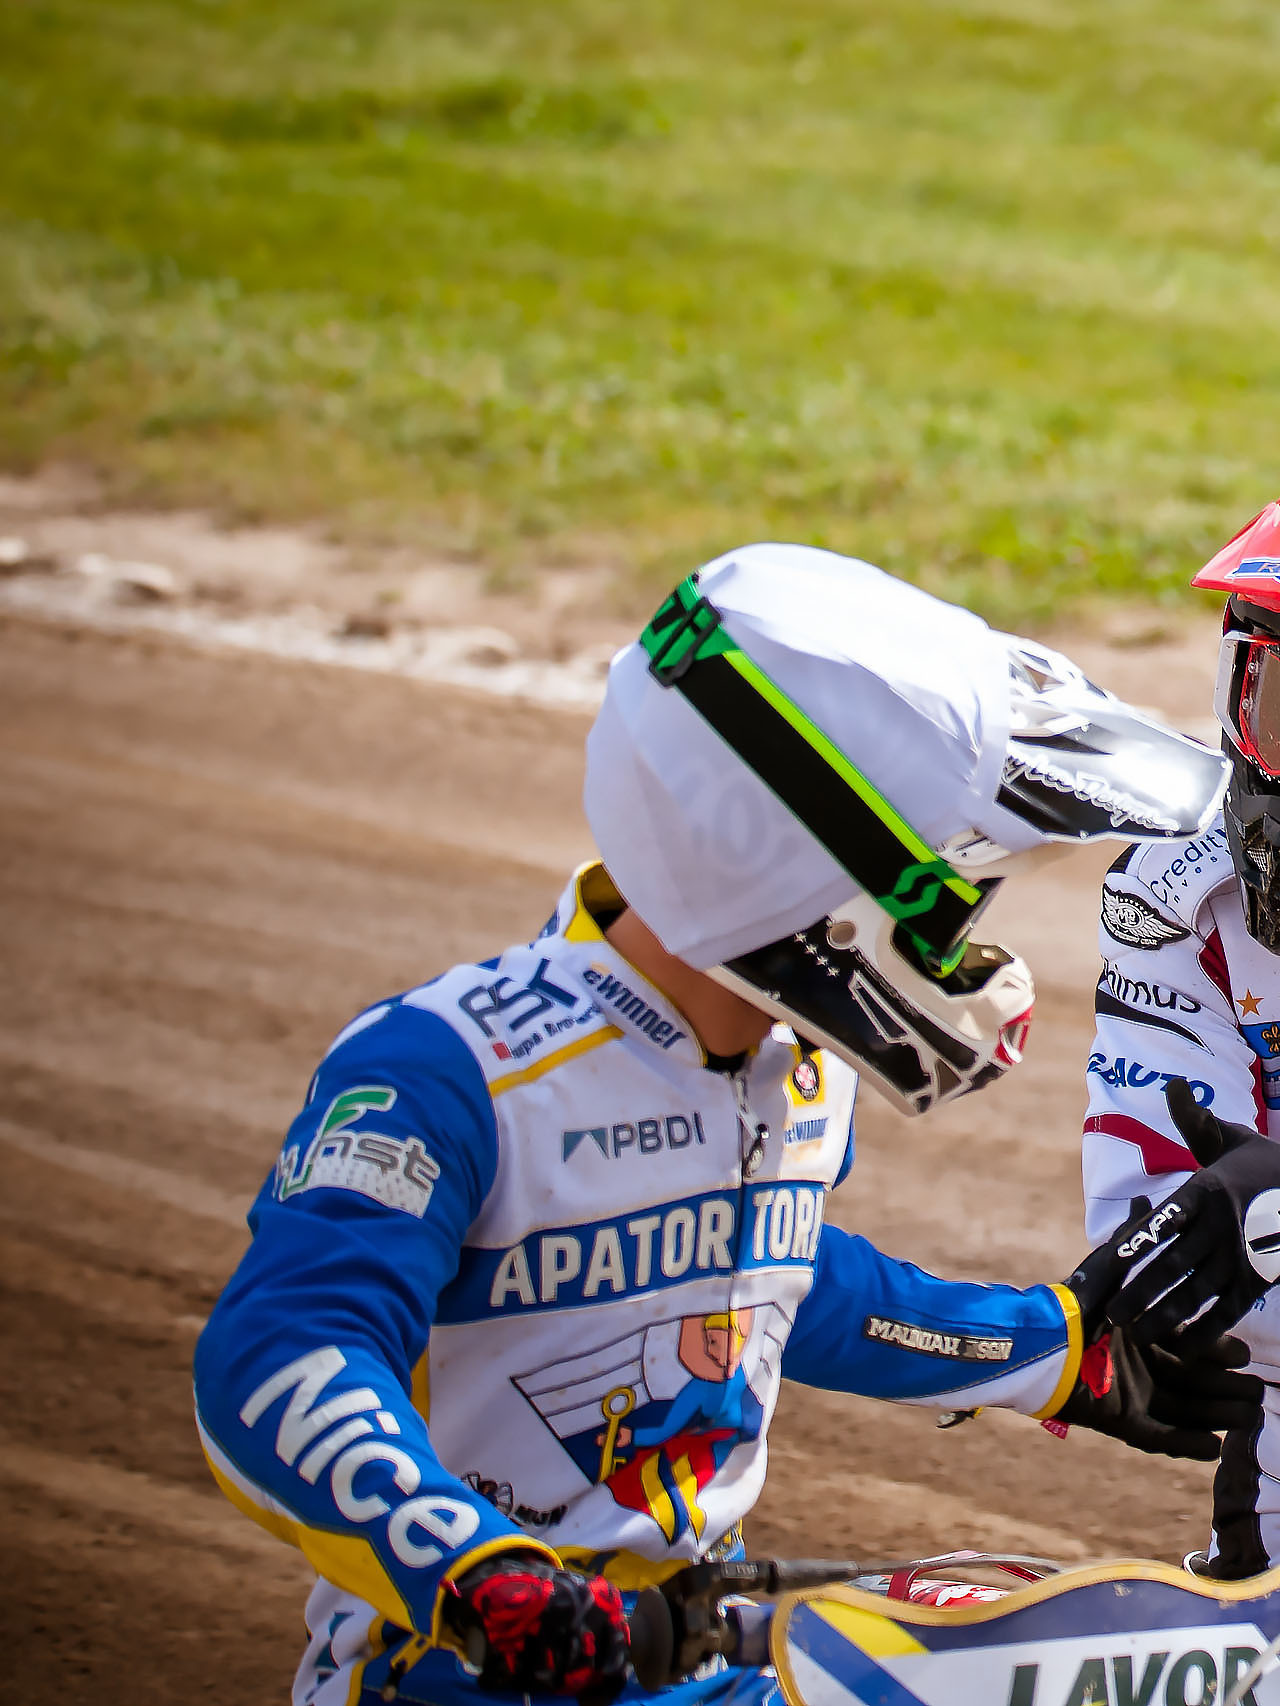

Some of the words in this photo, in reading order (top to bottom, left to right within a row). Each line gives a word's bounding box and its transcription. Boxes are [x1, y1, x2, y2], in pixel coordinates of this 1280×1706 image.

[489, 1197, 736, 1307] APATOR
[1117, 1201, 1183, 1258] seven
[239, 1346, 480, 1568] Nice
